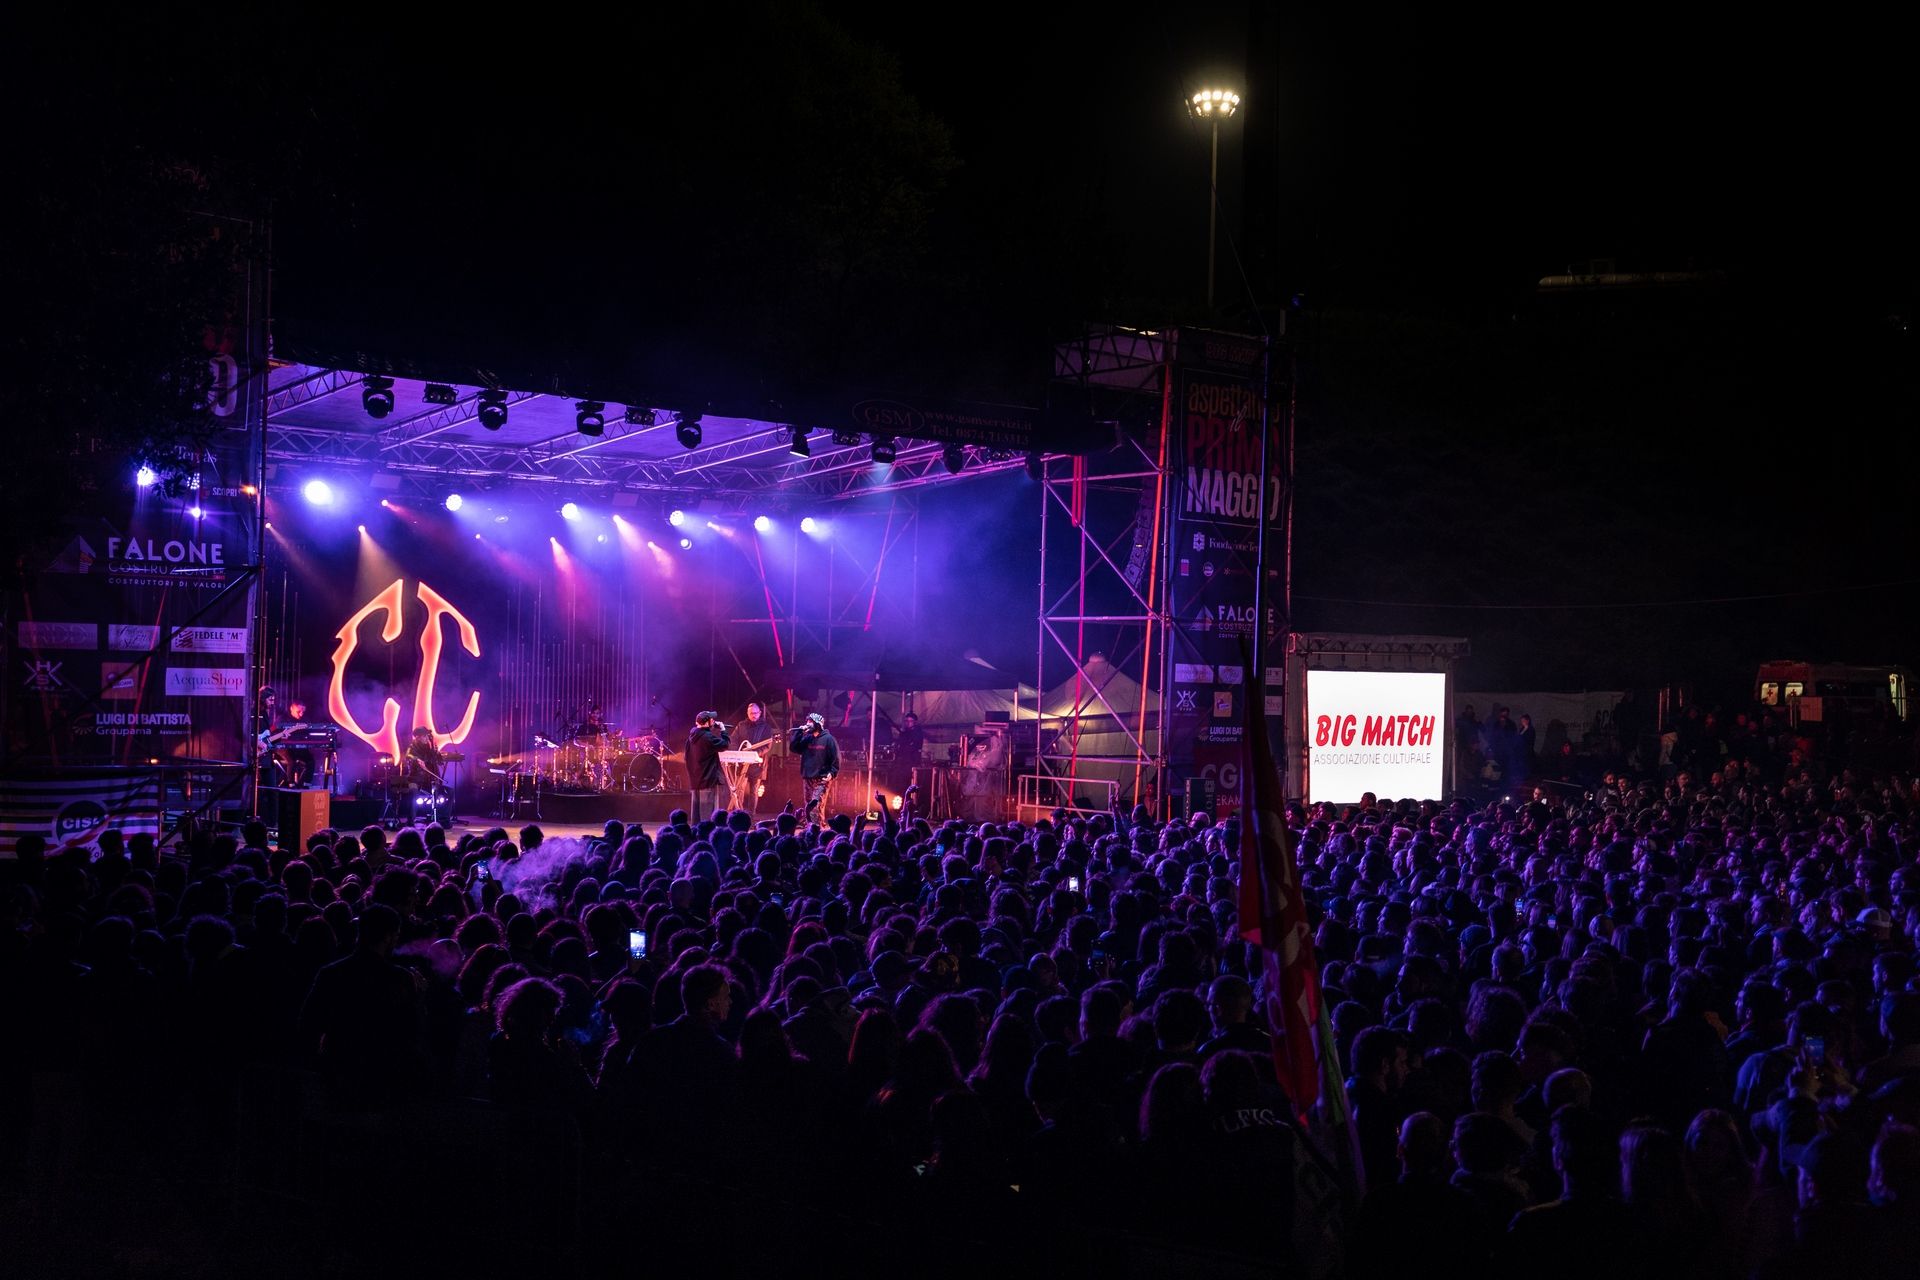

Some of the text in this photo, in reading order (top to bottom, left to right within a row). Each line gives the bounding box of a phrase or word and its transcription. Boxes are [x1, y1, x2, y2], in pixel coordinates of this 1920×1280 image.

[864, 406, 912, 428] GSM
[108, 537, 224, 564] FALONE
[108, 577, 174, 588] COSTRUTTORI
[1218, 605, 1275, 623] FALOE
[194, 631, 224, 640] FEDELE
[96, 713, 191, 725] LUIGI DI BATTISTA
[96, 726, 152, 737] Groupama
[1315, 714, 1435, 747] BIG MATCH
[1313, 752, 1431, 765] ASSOCIAZIONE CULTURALE
